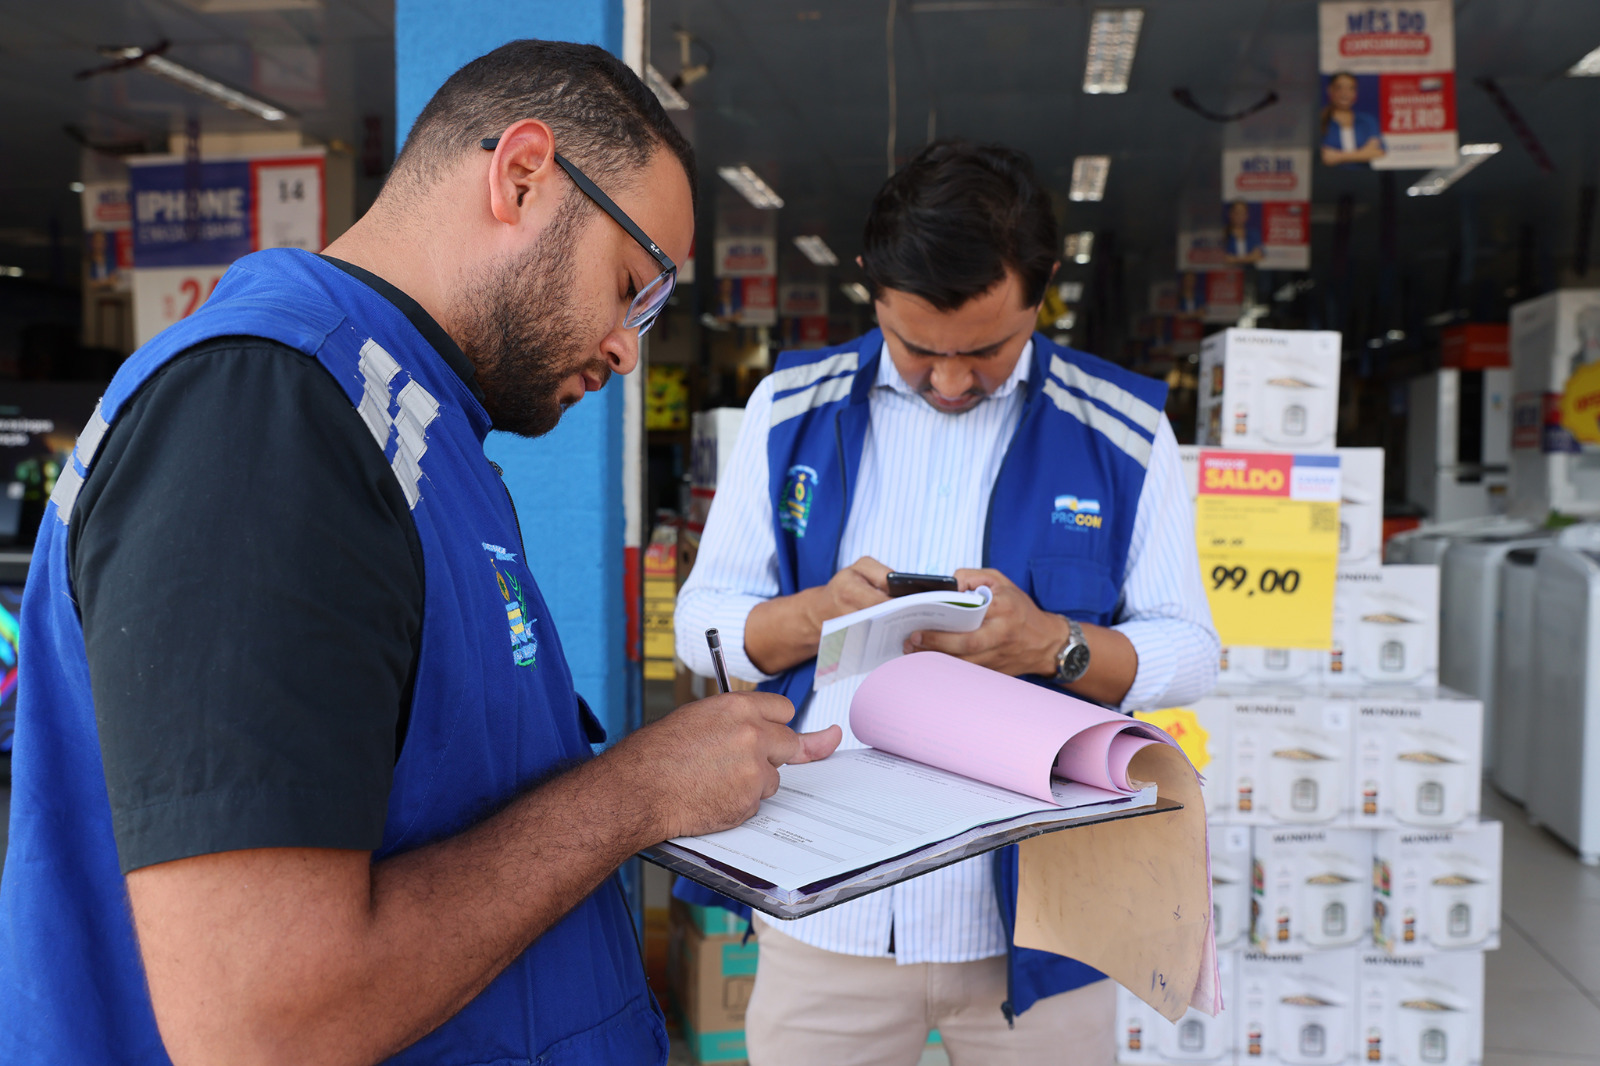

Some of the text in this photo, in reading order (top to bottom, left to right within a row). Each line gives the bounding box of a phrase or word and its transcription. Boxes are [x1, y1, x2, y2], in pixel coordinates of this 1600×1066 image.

[1347, 10, 1391, 33] MÊS
[1205, 468, 1285, 491] SALDO
[1211, 565, 1301, 597] 99,00
